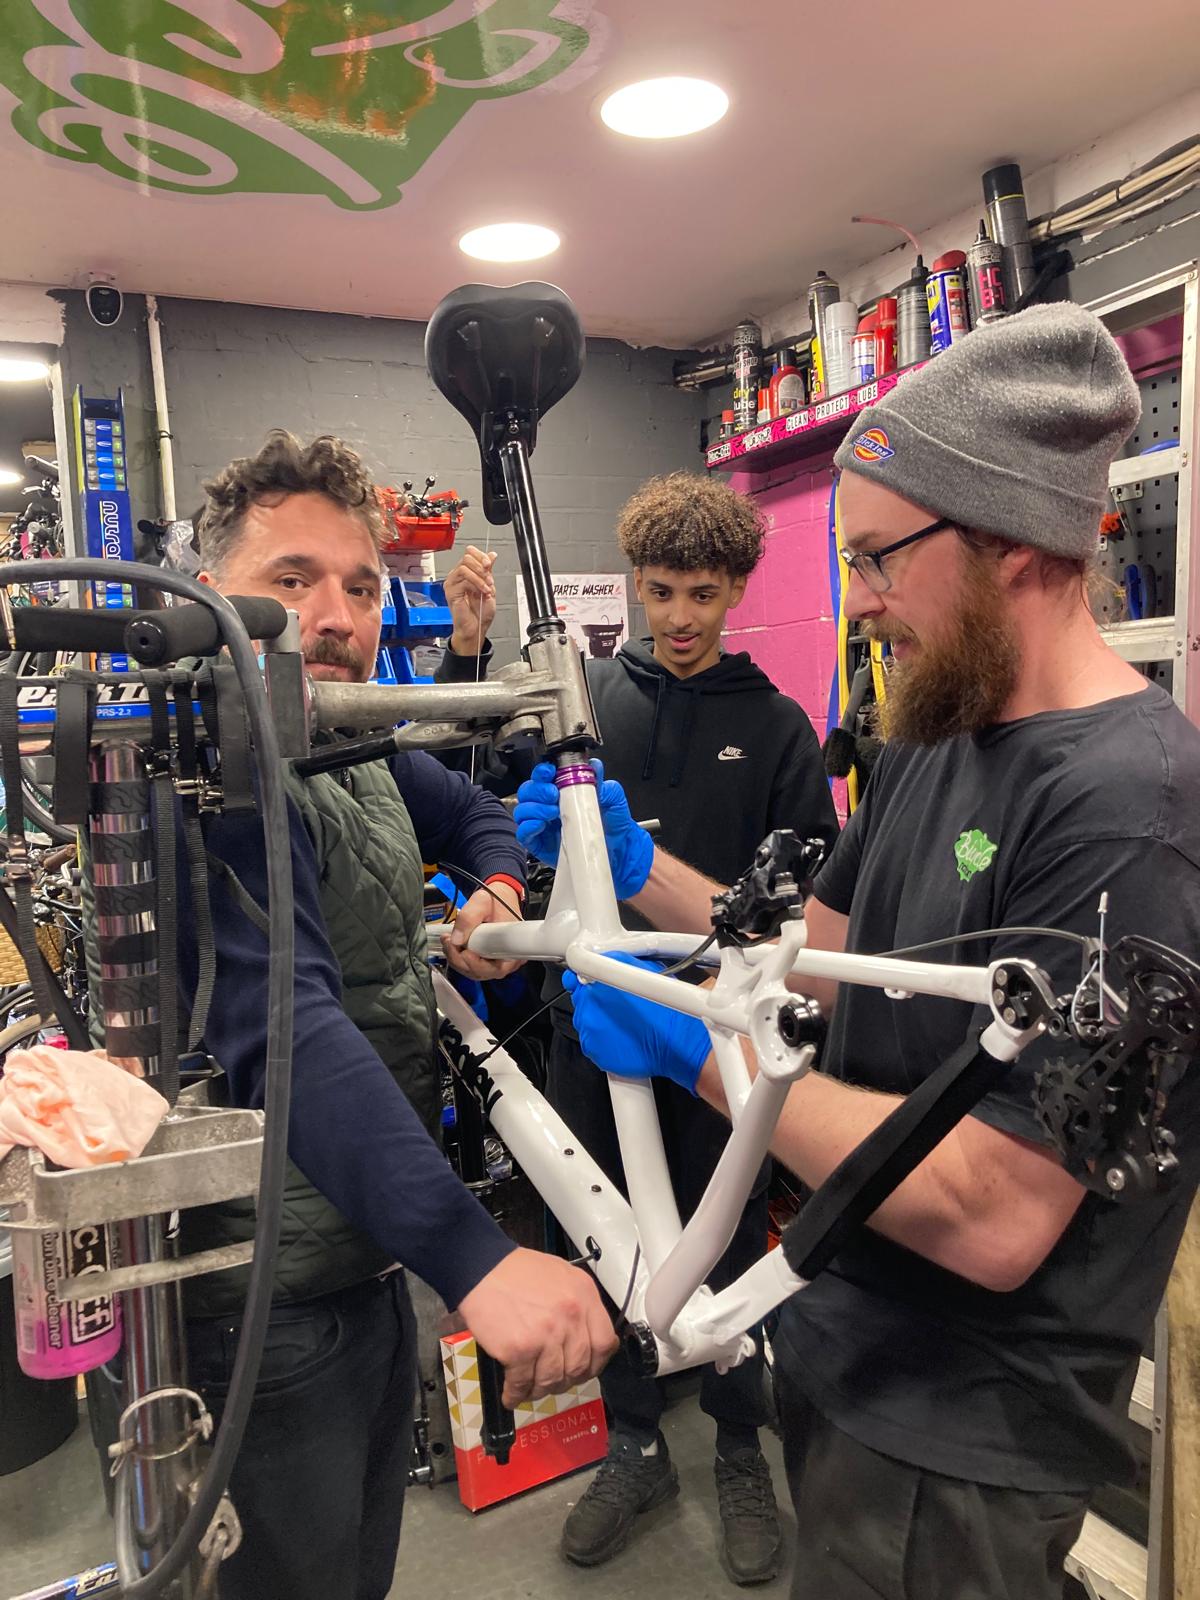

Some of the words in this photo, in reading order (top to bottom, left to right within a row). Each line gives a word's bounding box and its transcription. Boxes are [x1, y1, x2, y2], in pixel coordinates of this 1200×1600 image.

[858, 385, 877, 404] LUBE
[816, 397, 849, 419] PROTECT
[786, 412, 808, 431] CLEAN
[553, 584, 579, 596] PARTS
[582, 584, 614, 596] WASHER
[17, 683, 115, 707] Pak
[48, 1292, 61, 1348] cleaner
[477, 1409, 597, 1465] PESSIONAL
